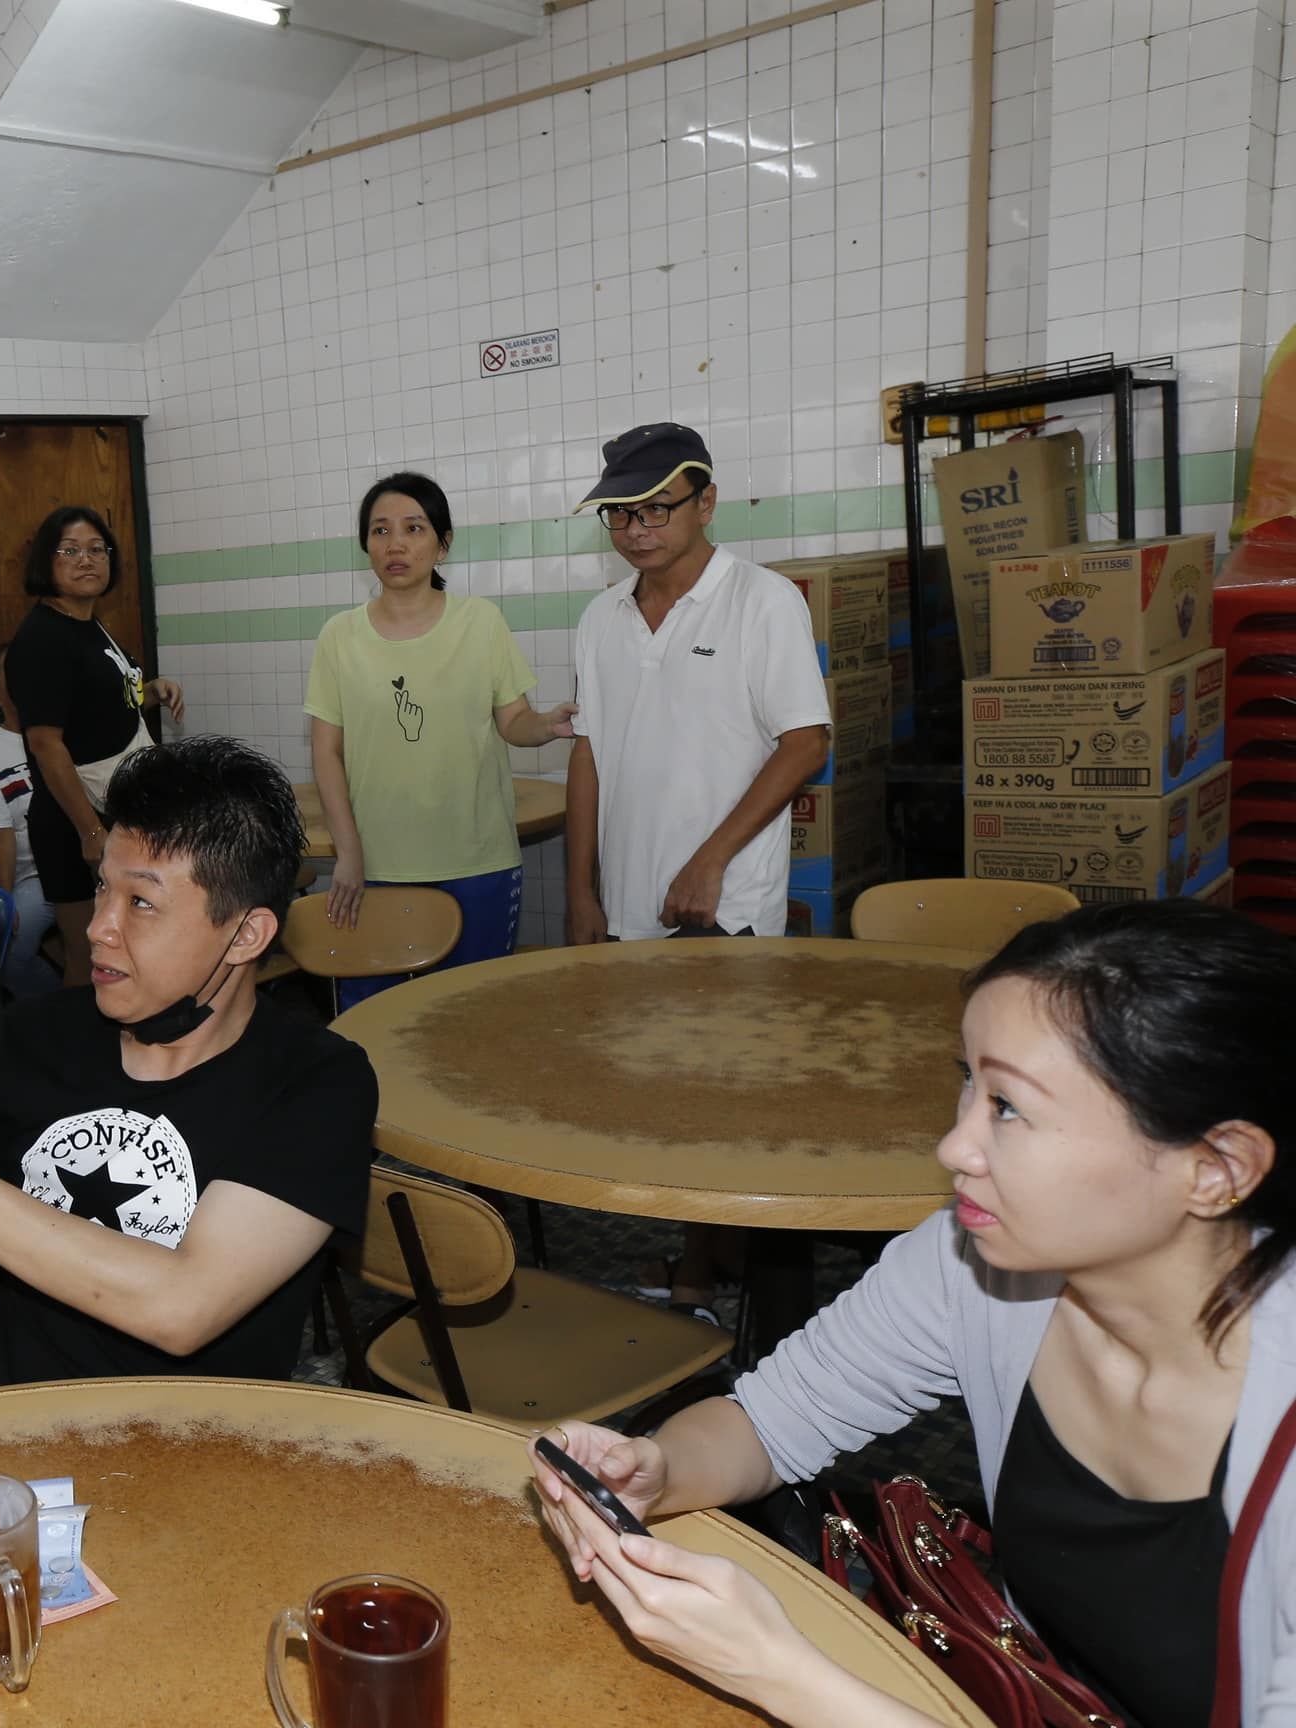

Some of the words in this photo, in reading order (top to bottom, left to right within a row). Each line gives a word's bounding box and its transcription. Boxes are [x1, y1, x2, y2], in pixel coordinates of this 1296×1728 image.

[510, 359, 520, 368] NO
[521, 354, 552, 366] SMOKING
[963, 523, 991, 535] STEEL
[993, 516, 1028, 530] RECON
[968, 529, 1024, 545] INDUSTRIES
[1085, 558, 1130, 571] 1111556
[1025, 582, 1102, 602] TEAPOT
[973, 685, 1005, 694] SIMPAN
[1019, 684, 1051, 693] TEMPAT
[1053, 683, 1086, 692] DINGIN
[1088, 682, 1108, 691] DAN
[1110, 681, 1145, 690] KERING
[983, 754, 1008, 764] 1800
[1012, 754, 1025, 764] 88
[1031, 754, 1056, 764] 5587
[975, 774, 995, 787] 48
[999, 777, 1009, 787] x
[1014, 774, 1055, 790] 390g
[973, 800, 993, 808] KEEP
[1014, 801, 1036, 809] COOL
[1039, 801, 1058, 809] AND
[1060, 802, 1077, 810] DRY
[1079, 802, 1106, 811] PLACE
[983, 866, 1008, 877] 1800
[1012, 867, 1025, 877] 88
[1028, 868, 1055, 878] 5587
[124, 1211, 178, 1238] Taylor
